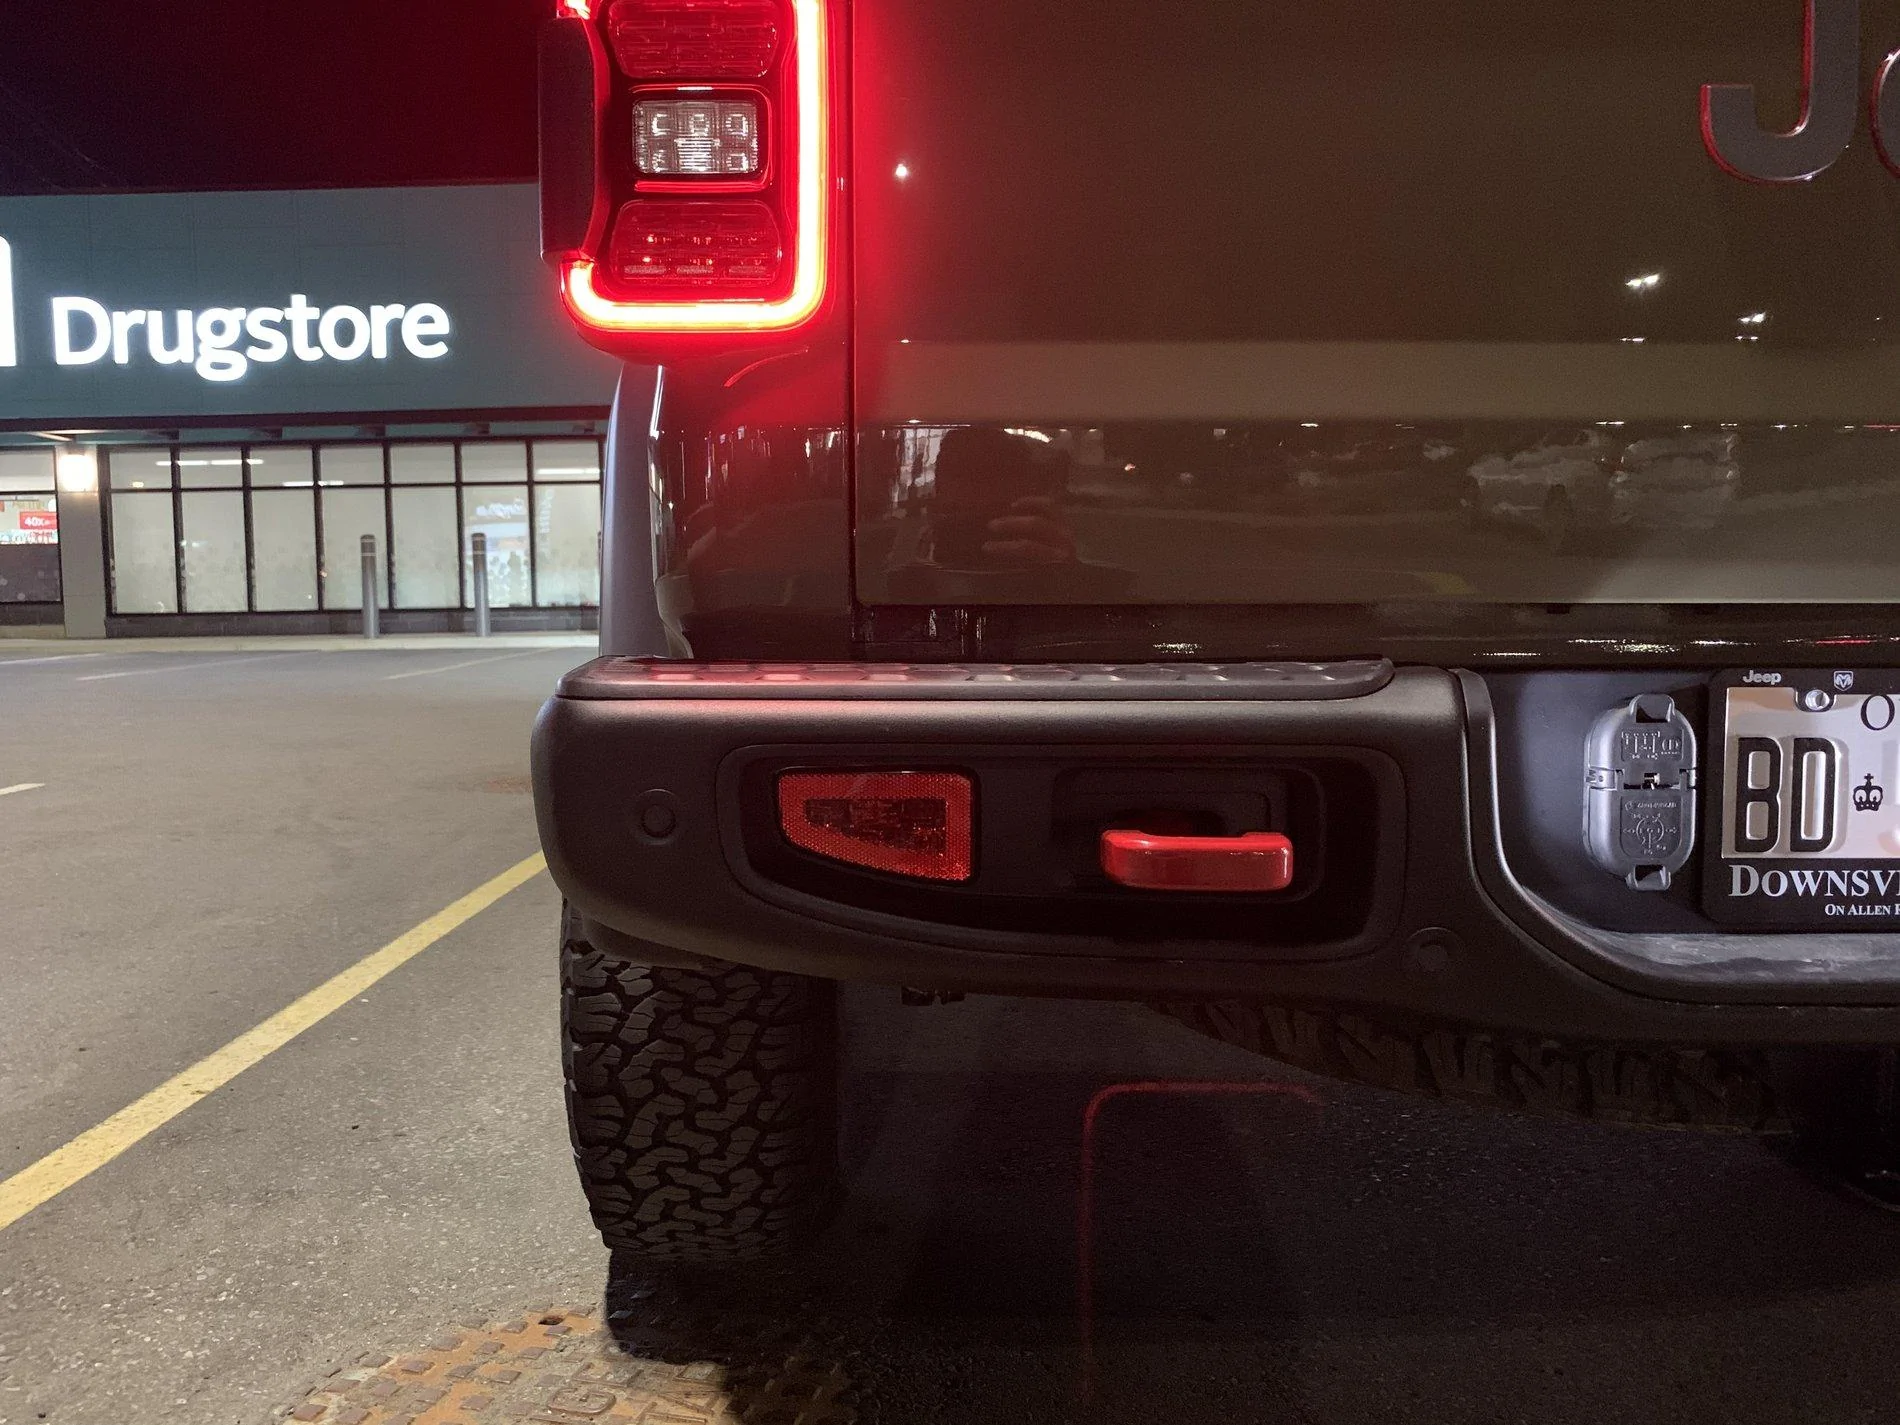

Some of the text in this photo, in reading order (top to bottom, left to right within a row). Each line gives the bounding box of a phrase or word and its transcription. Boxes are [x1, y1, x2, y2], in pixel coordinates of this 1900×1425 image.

[51, 293, 451, 382] Drugstore
[1742, 670, 1782, 685] Jeep
[1825, 903, 1844, 916] ON
[1848, 903, 1892, 916] ALLEN
